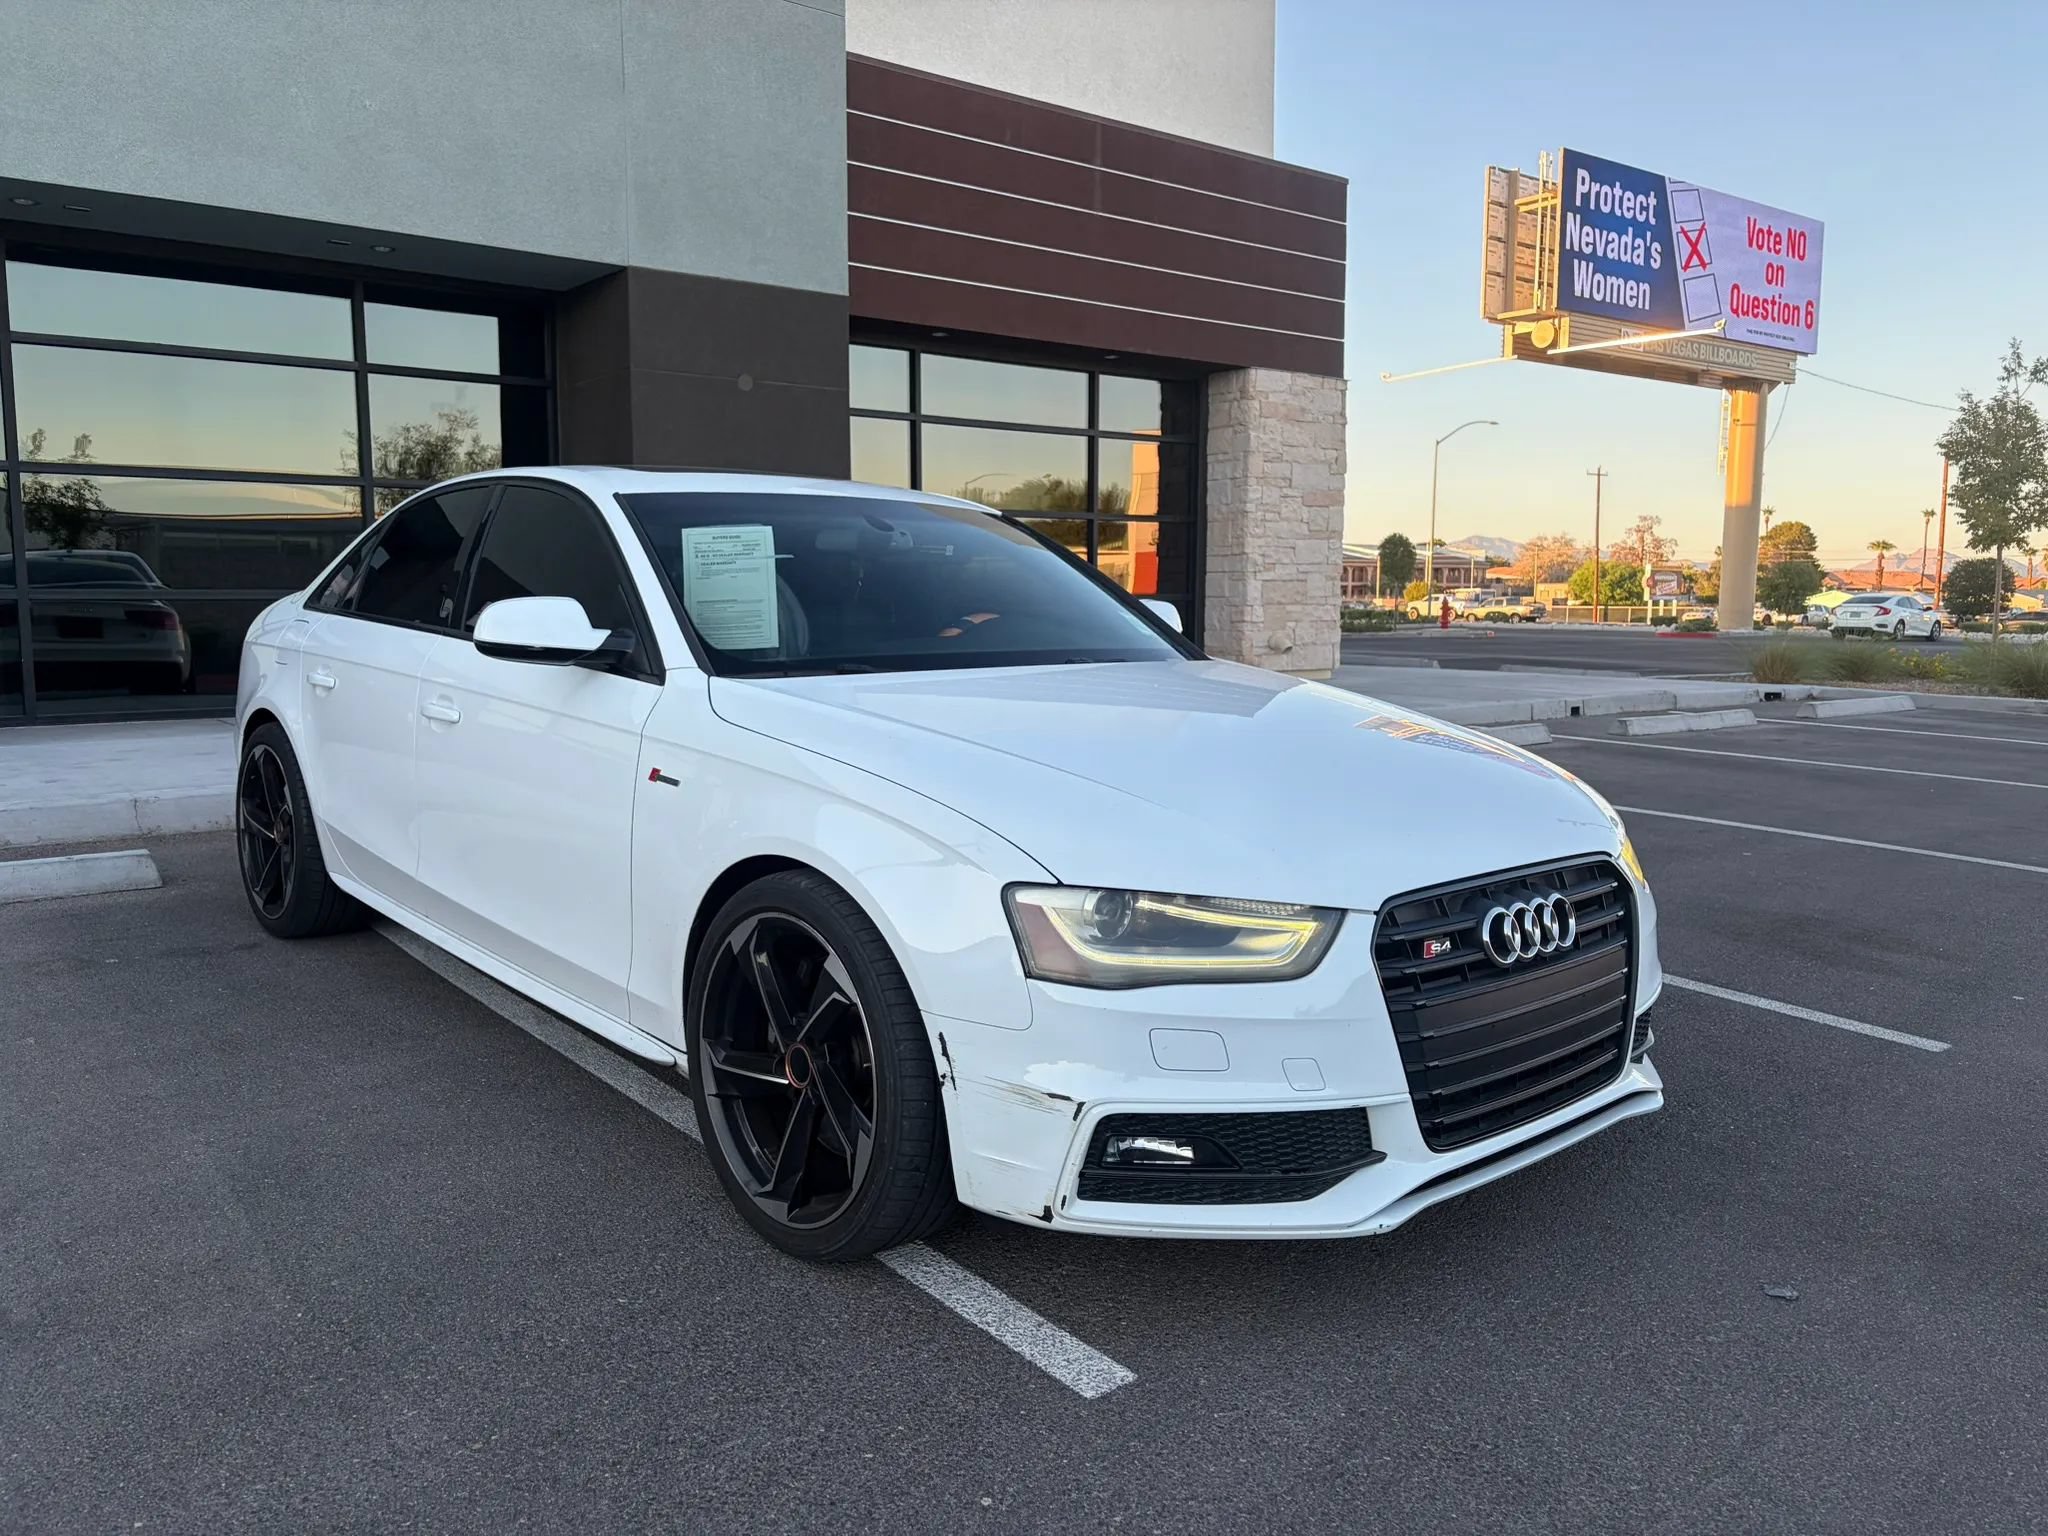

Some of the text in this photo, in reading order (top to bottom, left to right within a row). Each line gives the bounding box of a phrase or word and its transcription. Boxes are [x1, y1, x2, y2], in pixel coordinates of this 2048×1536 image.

[1575, 168, 1657, 225] Protect
[1565, 212, 1662, 270] Nevada's
[1747, 216, 1807, 261] Vote NO
[1573, 259, 1650, 310] Women
[1765, 262, 1784, 287] on
[1730, 283, 1815, 330] Question 6
[1665, 339, 1699, 358] VEGAS
[1700, 343, 1758, 369] BILLBOARDS
[1430, 940, 1452, 954] S4
